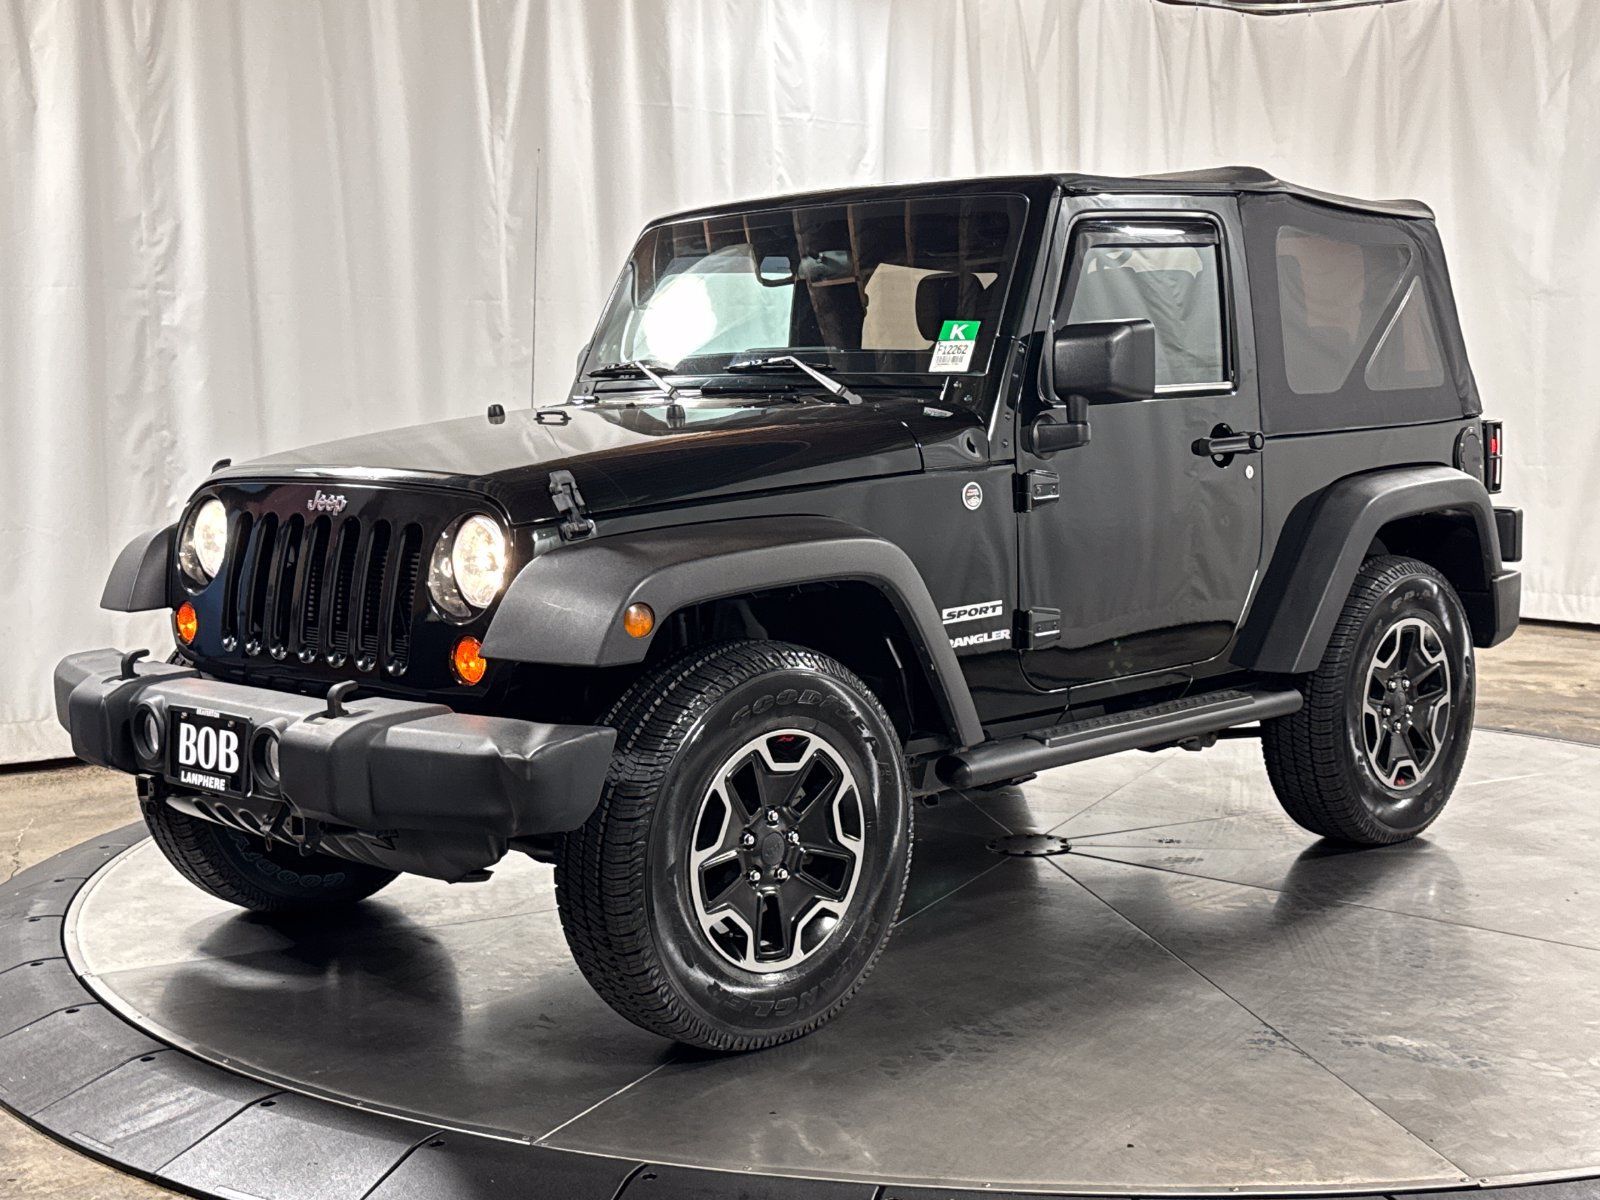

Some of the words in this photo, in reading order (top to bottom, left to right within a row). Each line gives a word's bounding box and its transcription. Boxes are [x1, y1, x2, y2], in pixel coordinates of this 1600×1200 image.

[949, 324, 970, 340] K
[307, 490, 348, 516] Jeep
[946, 604, 1000, 621] SPORT
[949, 629, 1011, 649] ANGLER
[178, 722, 240, 774] BOB
[180, 770, 226, 792] LANPHERE
